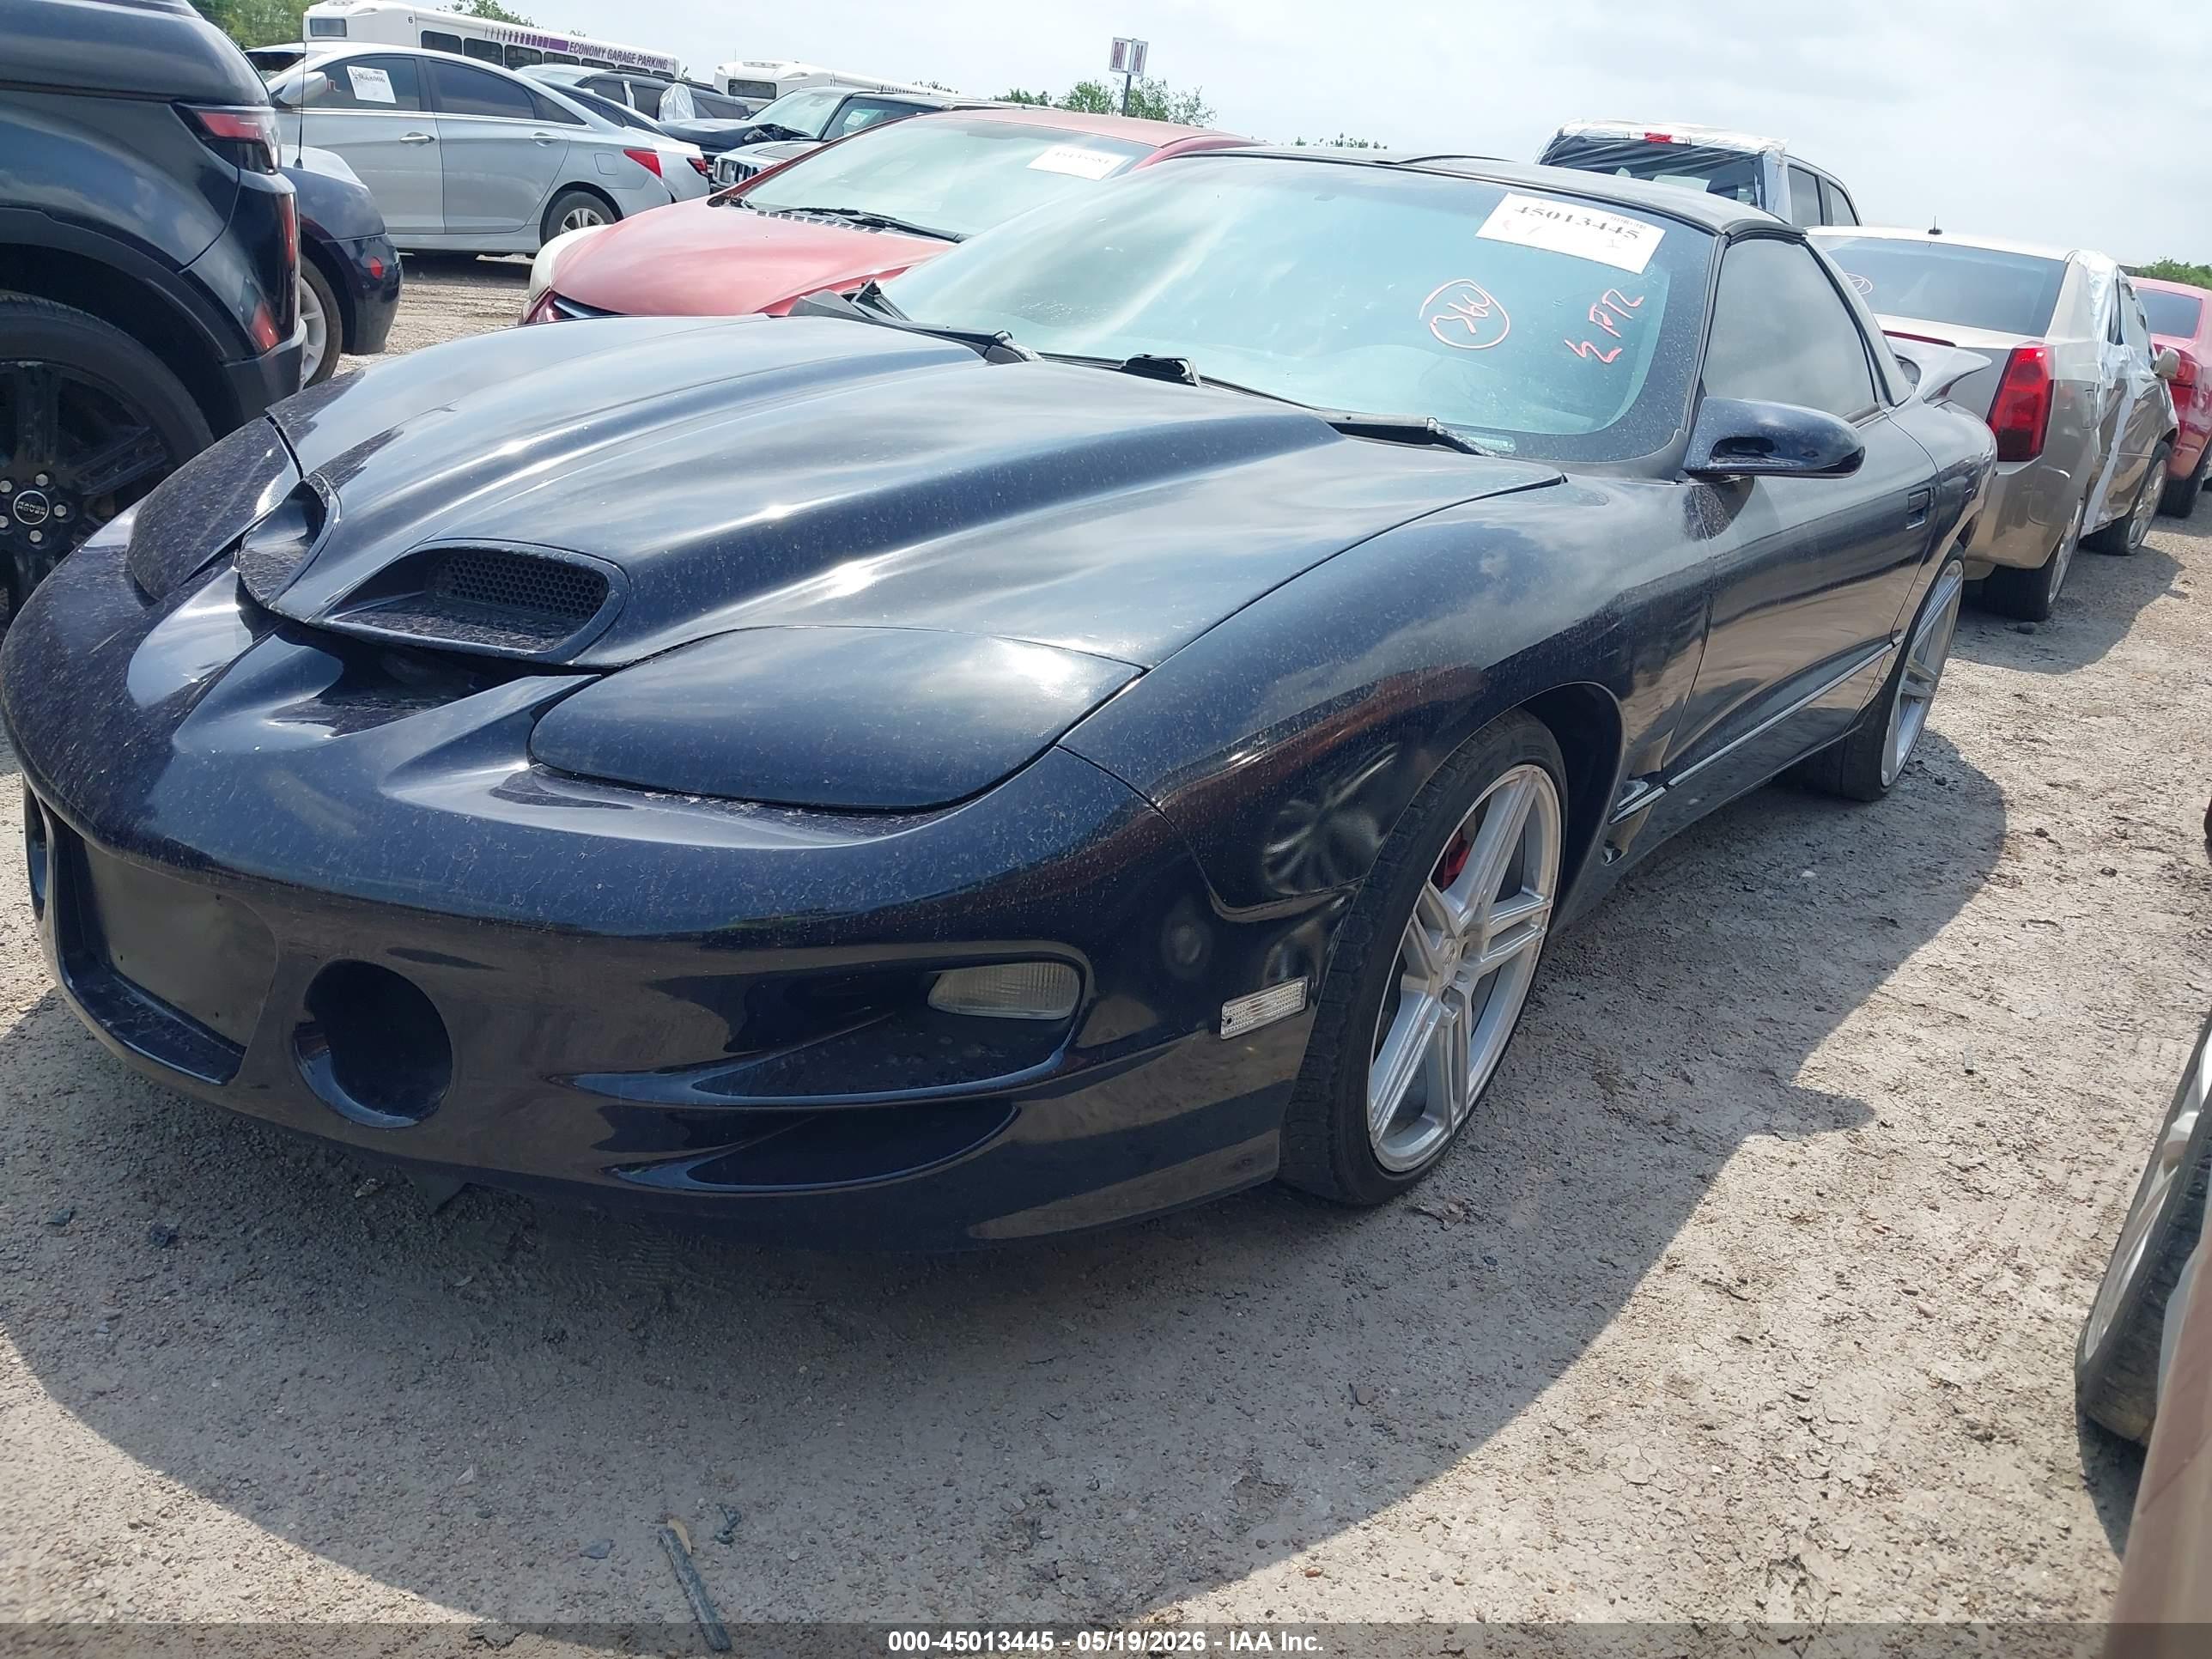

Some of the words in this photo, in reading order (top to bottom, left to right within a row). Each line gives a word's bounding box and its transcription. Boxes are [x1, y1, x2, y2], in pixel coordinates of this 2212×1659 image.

[568, 42, 606, 58] ECONOMY
[607, 49, 636, 64] GARAGE
[637, 55, 668, 70] PARKING
[1133, 45, 1144, 72] N
[1514, 206, 1640, 240] 45013445
[17, 505, 45, 515] ROVER
[18, 501, 46, 511] RANGE
